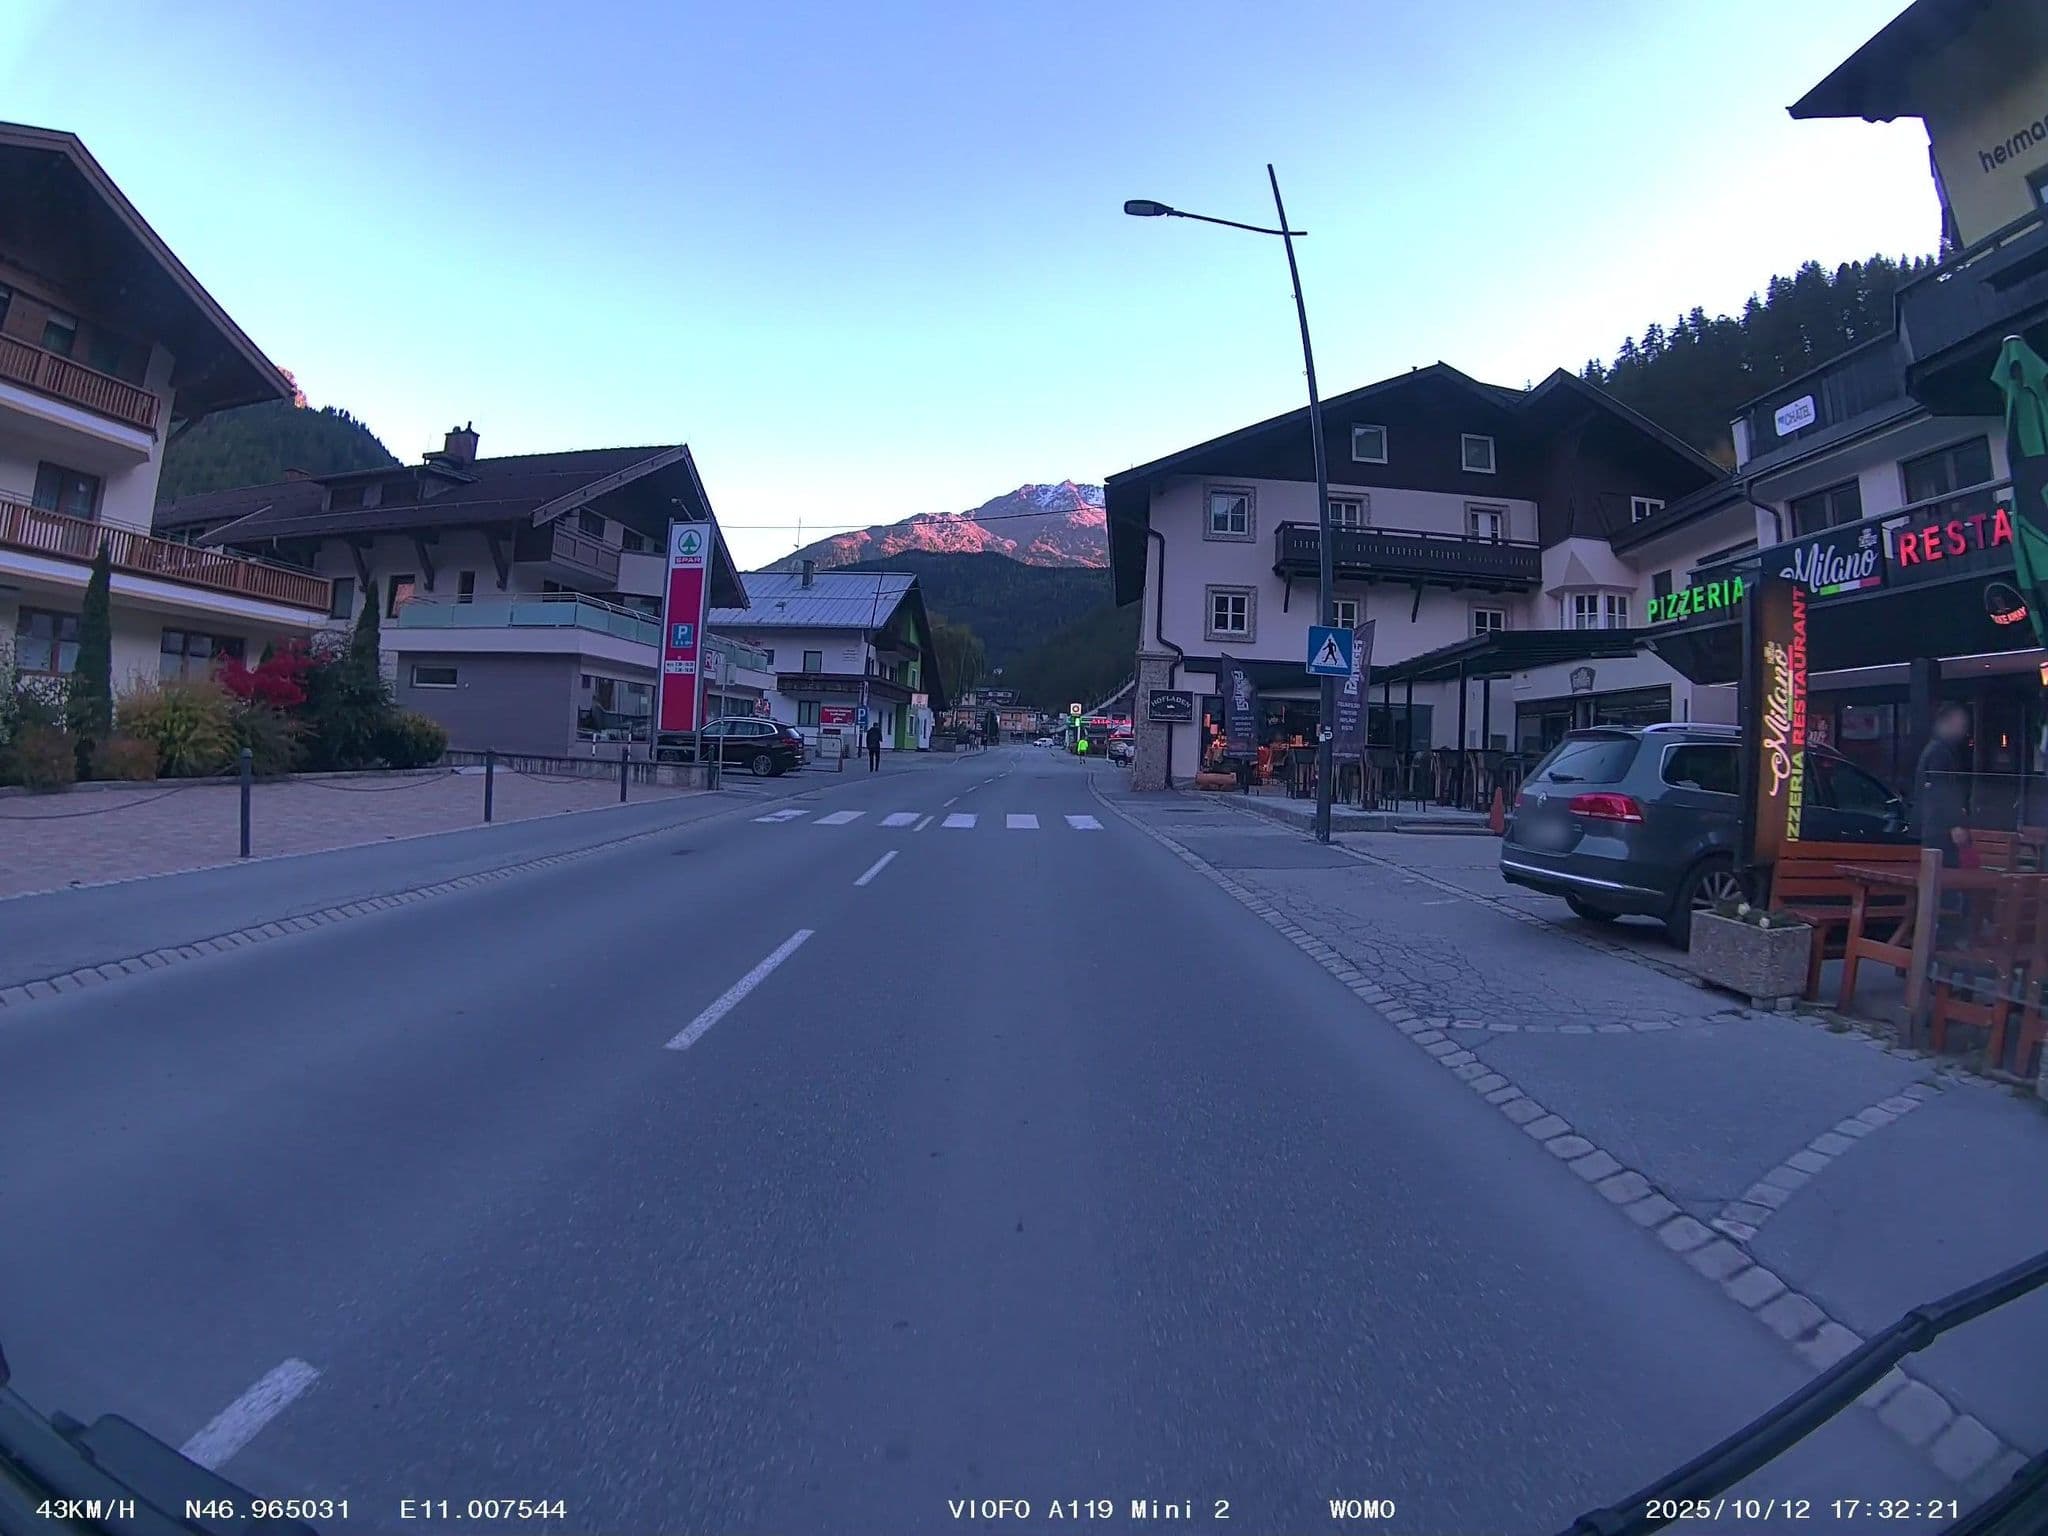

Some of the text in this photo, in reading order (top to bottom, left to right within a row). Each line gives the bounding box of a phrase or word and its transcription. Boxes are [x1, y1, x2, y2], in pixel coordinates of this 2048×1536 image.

[1979, 114, 2048, 173] herma
[1779, 543, 1878, 593] Milano
[1647, 576, 1744, 622] PIZZERIA
[678, 625, 688, 640] P
[1792, 585, 1807, 745] RESTAURANT
[1151, 695, 1192, 708] HOFLADEN
[1763, 643, 1791, 797] Milano
